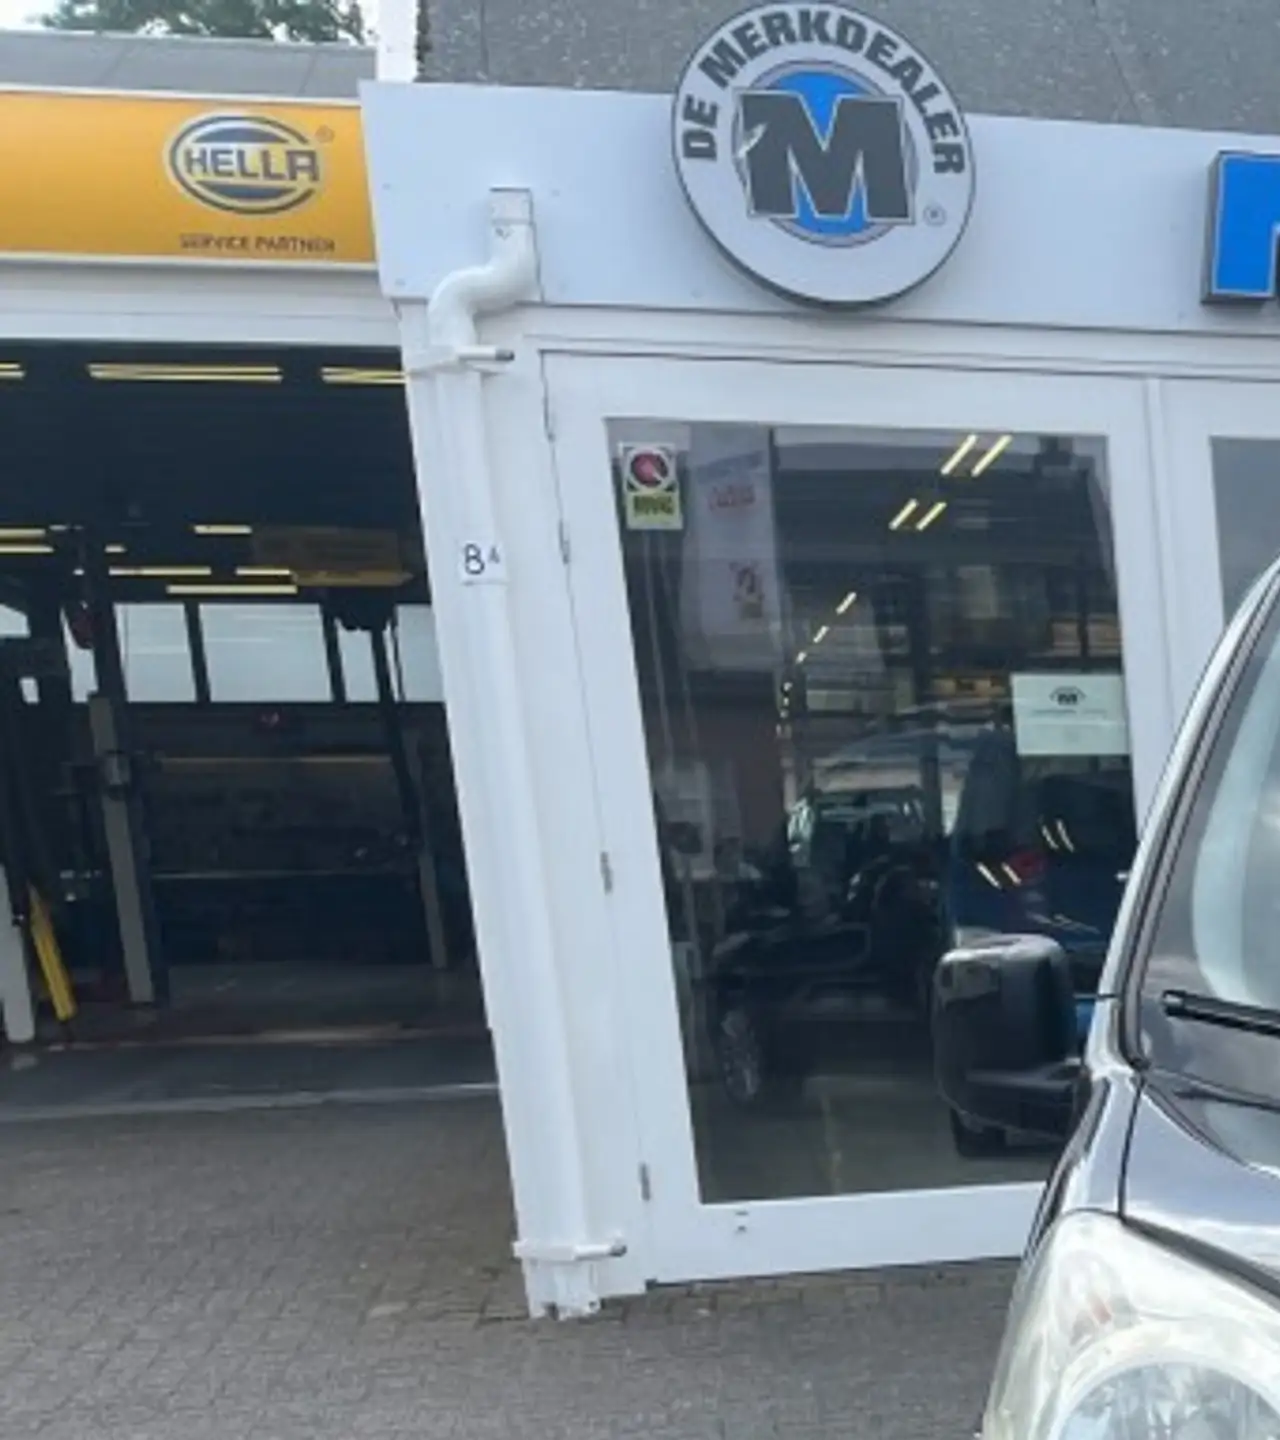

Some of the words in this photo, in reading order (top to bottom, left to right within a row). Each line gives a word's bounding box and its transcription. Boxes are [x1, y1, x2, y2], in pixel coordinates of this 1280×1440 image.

[682, 94, 718, 161] DE
[697, 8, 966, 174] MERKDEALER
[184, 147, 320, 182] HELLA
[738, 92, 912, 220] M
